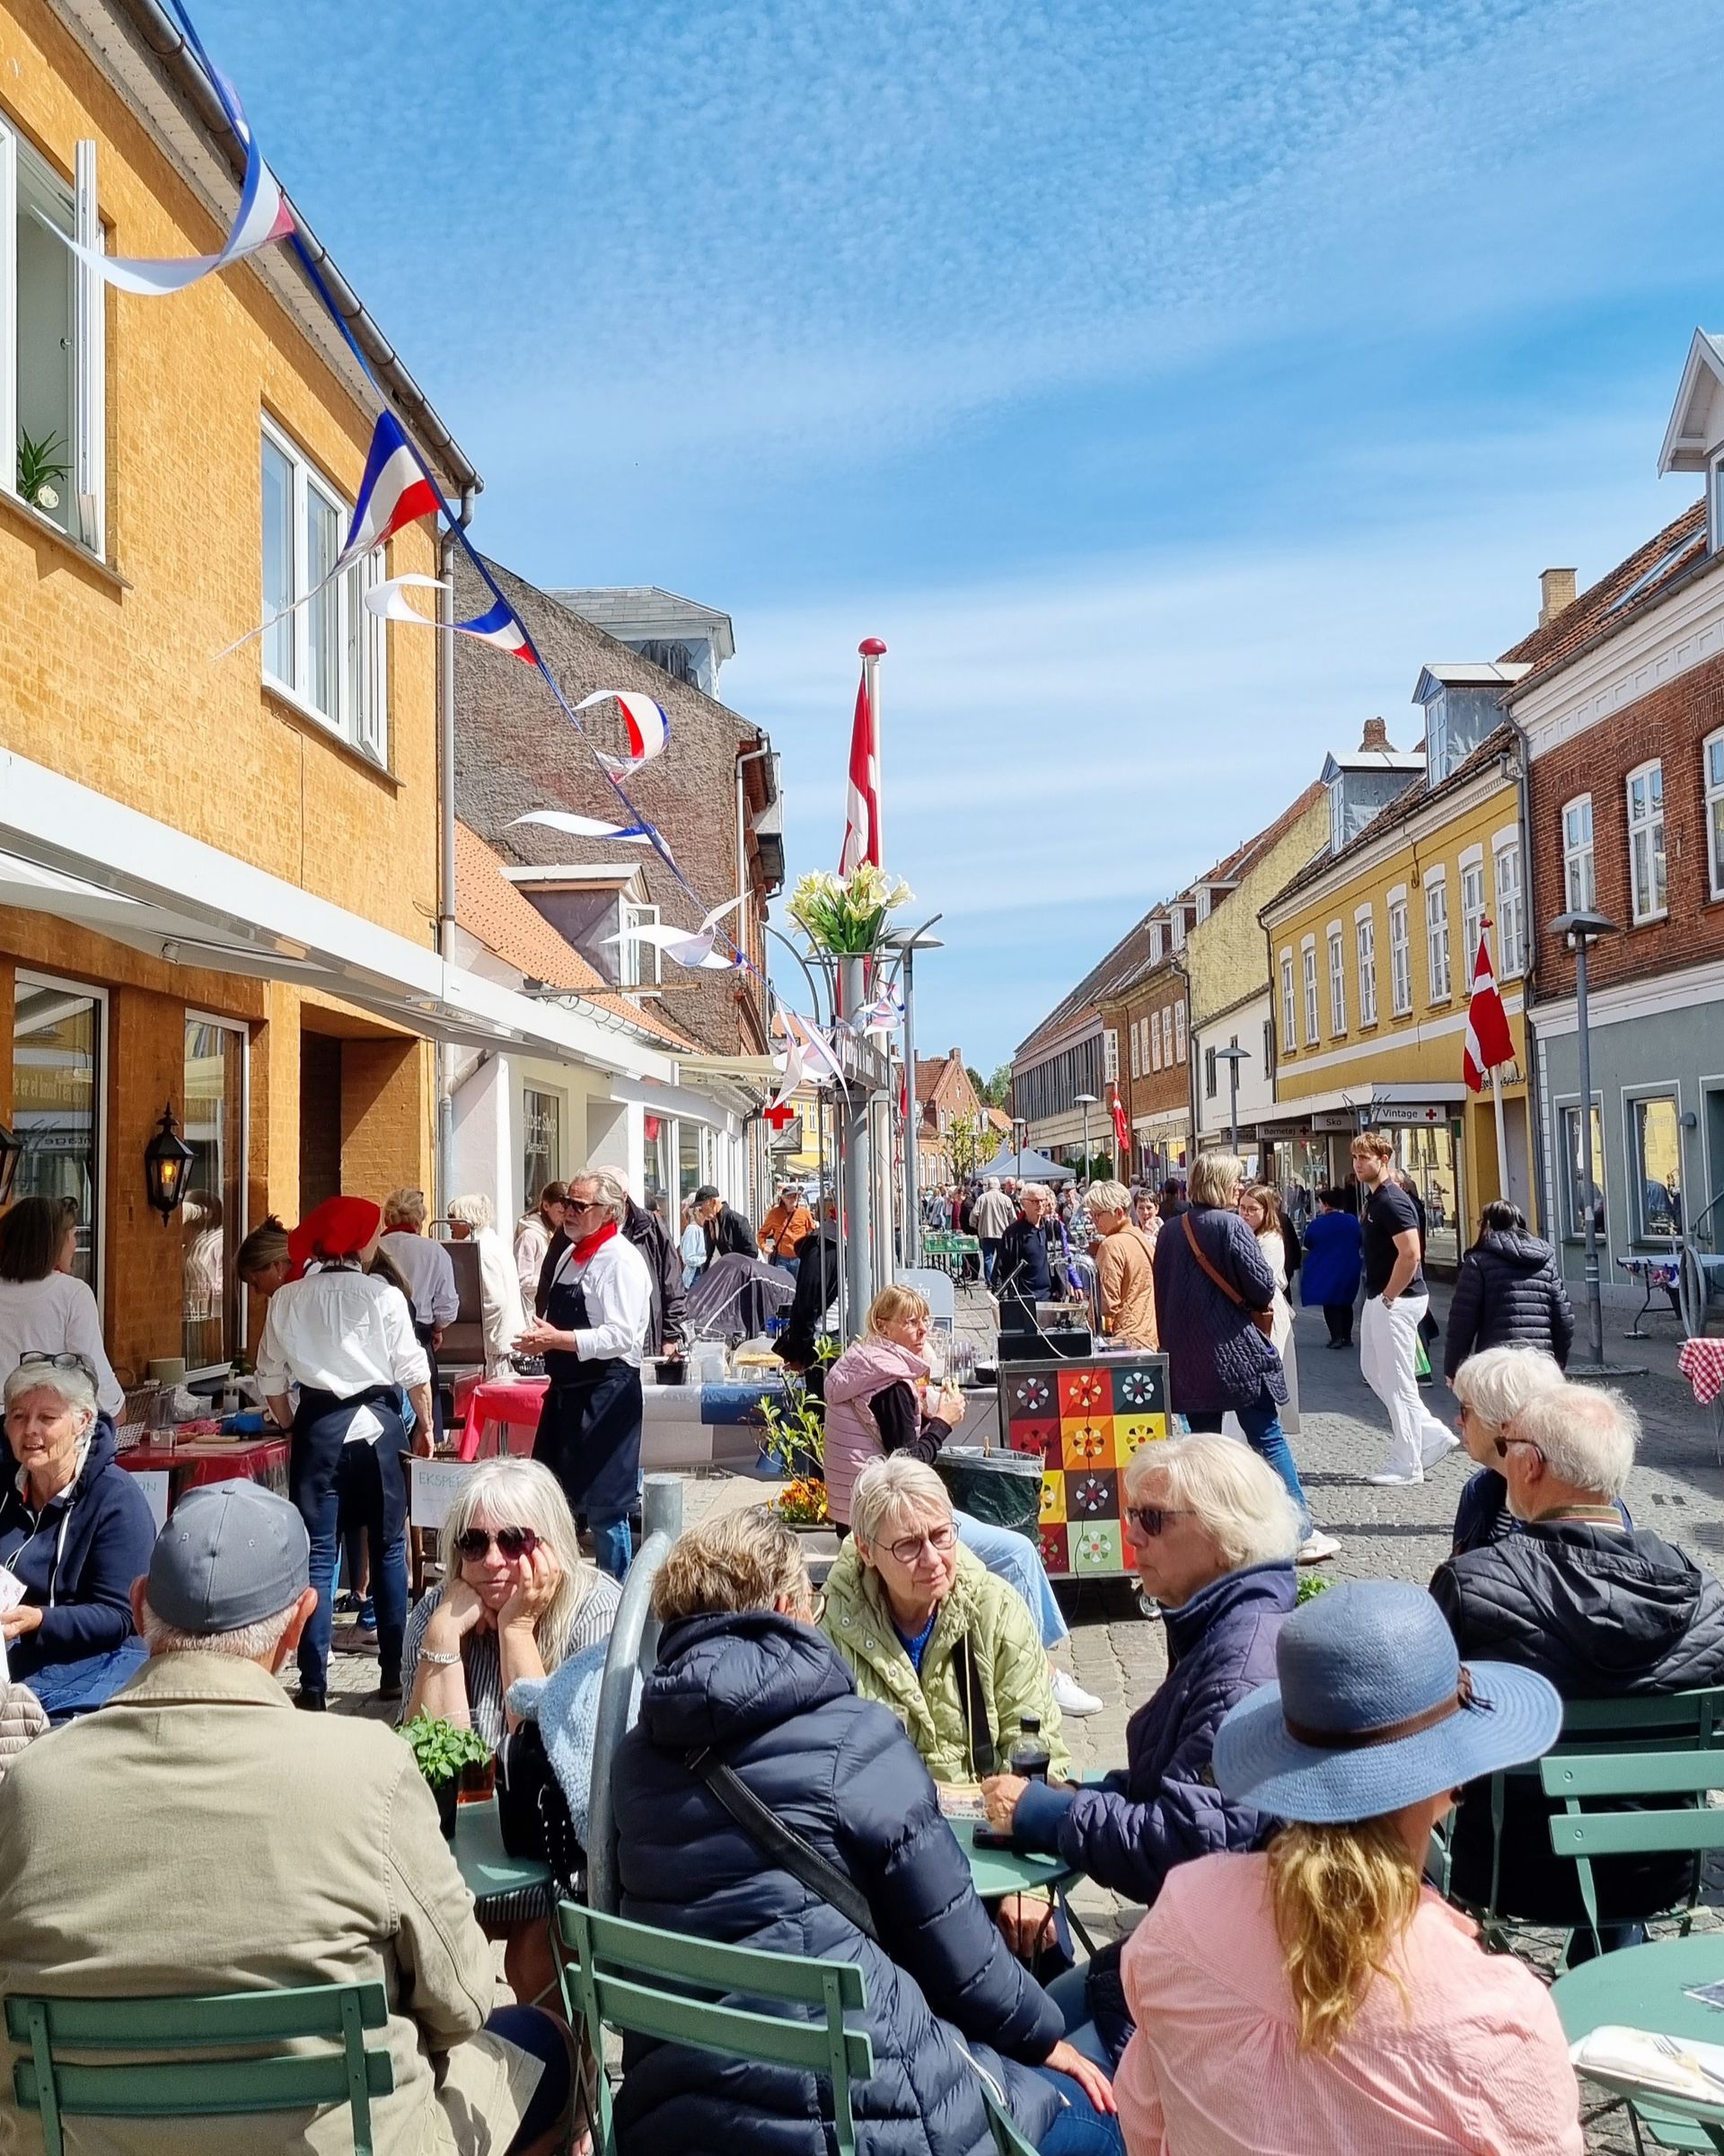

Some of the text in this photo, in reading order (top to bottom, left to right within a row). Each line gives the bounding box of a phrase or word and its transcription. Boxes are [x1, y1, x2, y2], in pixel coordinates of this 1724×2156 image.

[1383, 1108, 1418, 1118] Vintage
[1326, 1117, 1341, 1126] Sko
[1263, 1127, 1296, 1136] Børnetøj
